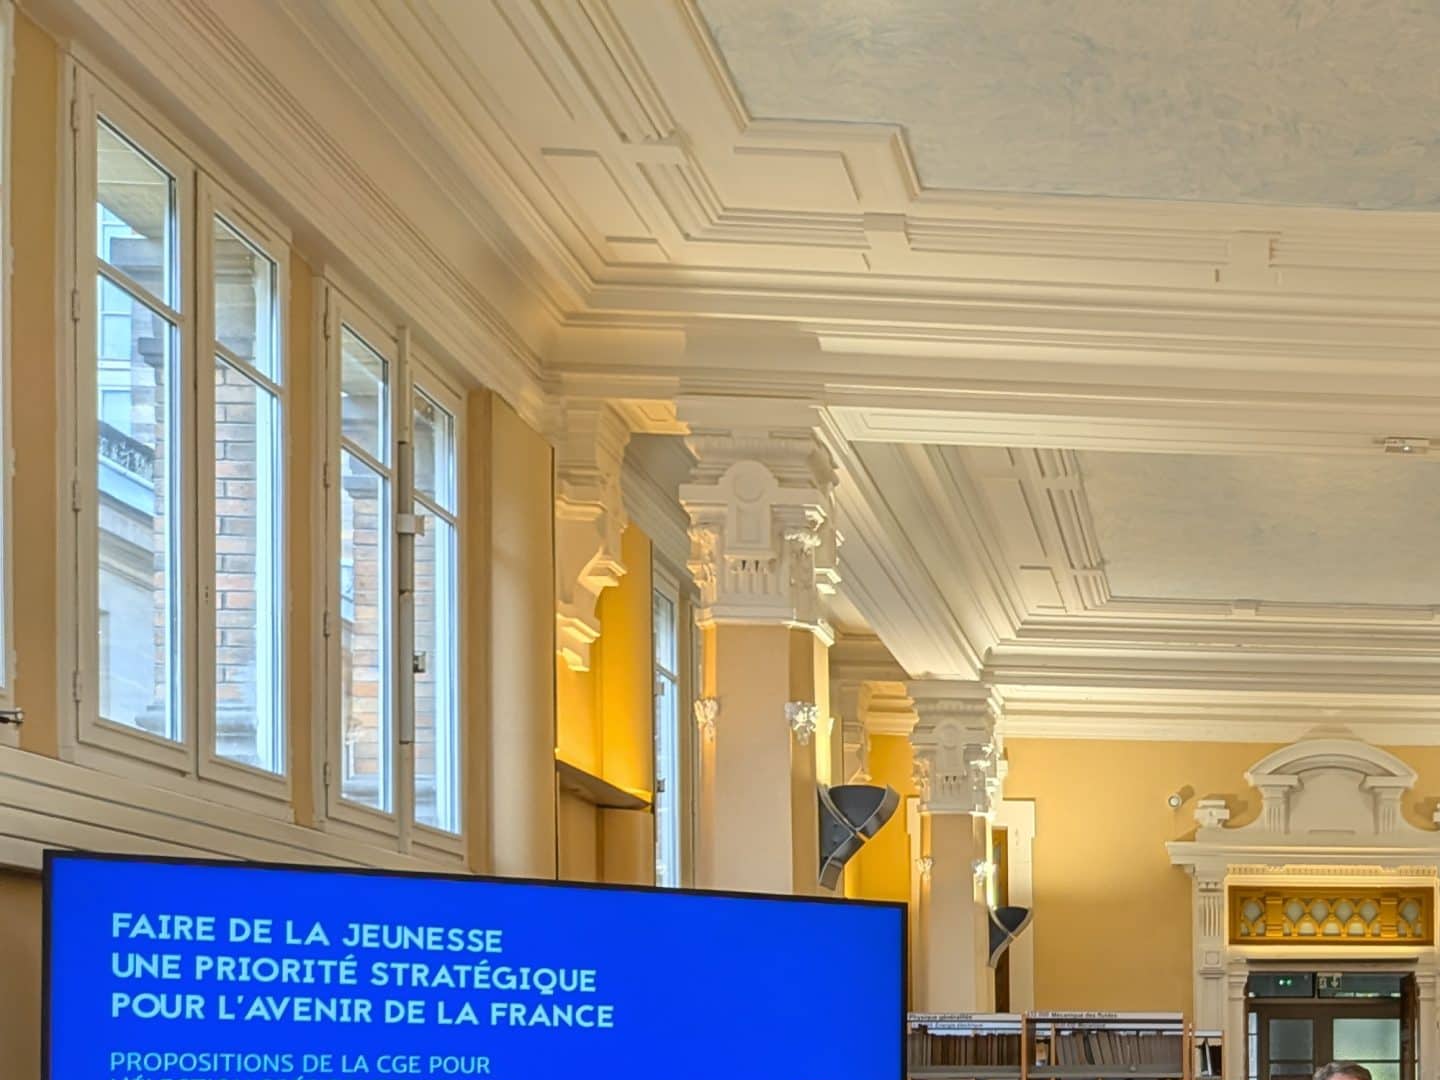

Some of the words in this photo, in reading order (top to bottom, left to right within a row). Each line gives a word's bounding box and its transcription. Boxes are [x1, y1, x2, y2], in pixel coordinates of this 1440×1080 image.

[113, 912, 215, 942] FAIRE
[230, 917, 272, 944] DE
[286, 920, 331, 946] LA
[342, 923, 503, 953] JEUNESSE
[111, 952, 181, 980] UNE
[195, 953, 358, 985] PRIORITÉ
[371, 959, 597, 996] STRATÉGIQUE
[111, 992, 205, 1020] POUR
[219, 995, 372, 1023] L'AVENIR
[384, 999, 426, 1024] DE
[437, 1000, 480, 1025] LA
[491, 1002, 614, 1028] FRANCE
[110, 1051, 294, 1073] PROPOSITIONS
[302, 1054, 333, 1073] DE
[341, 1054, 370, 1073] LA
[377, 1055, 421, 1074] CGE
[429, 1055, 491, 1074] POUR
